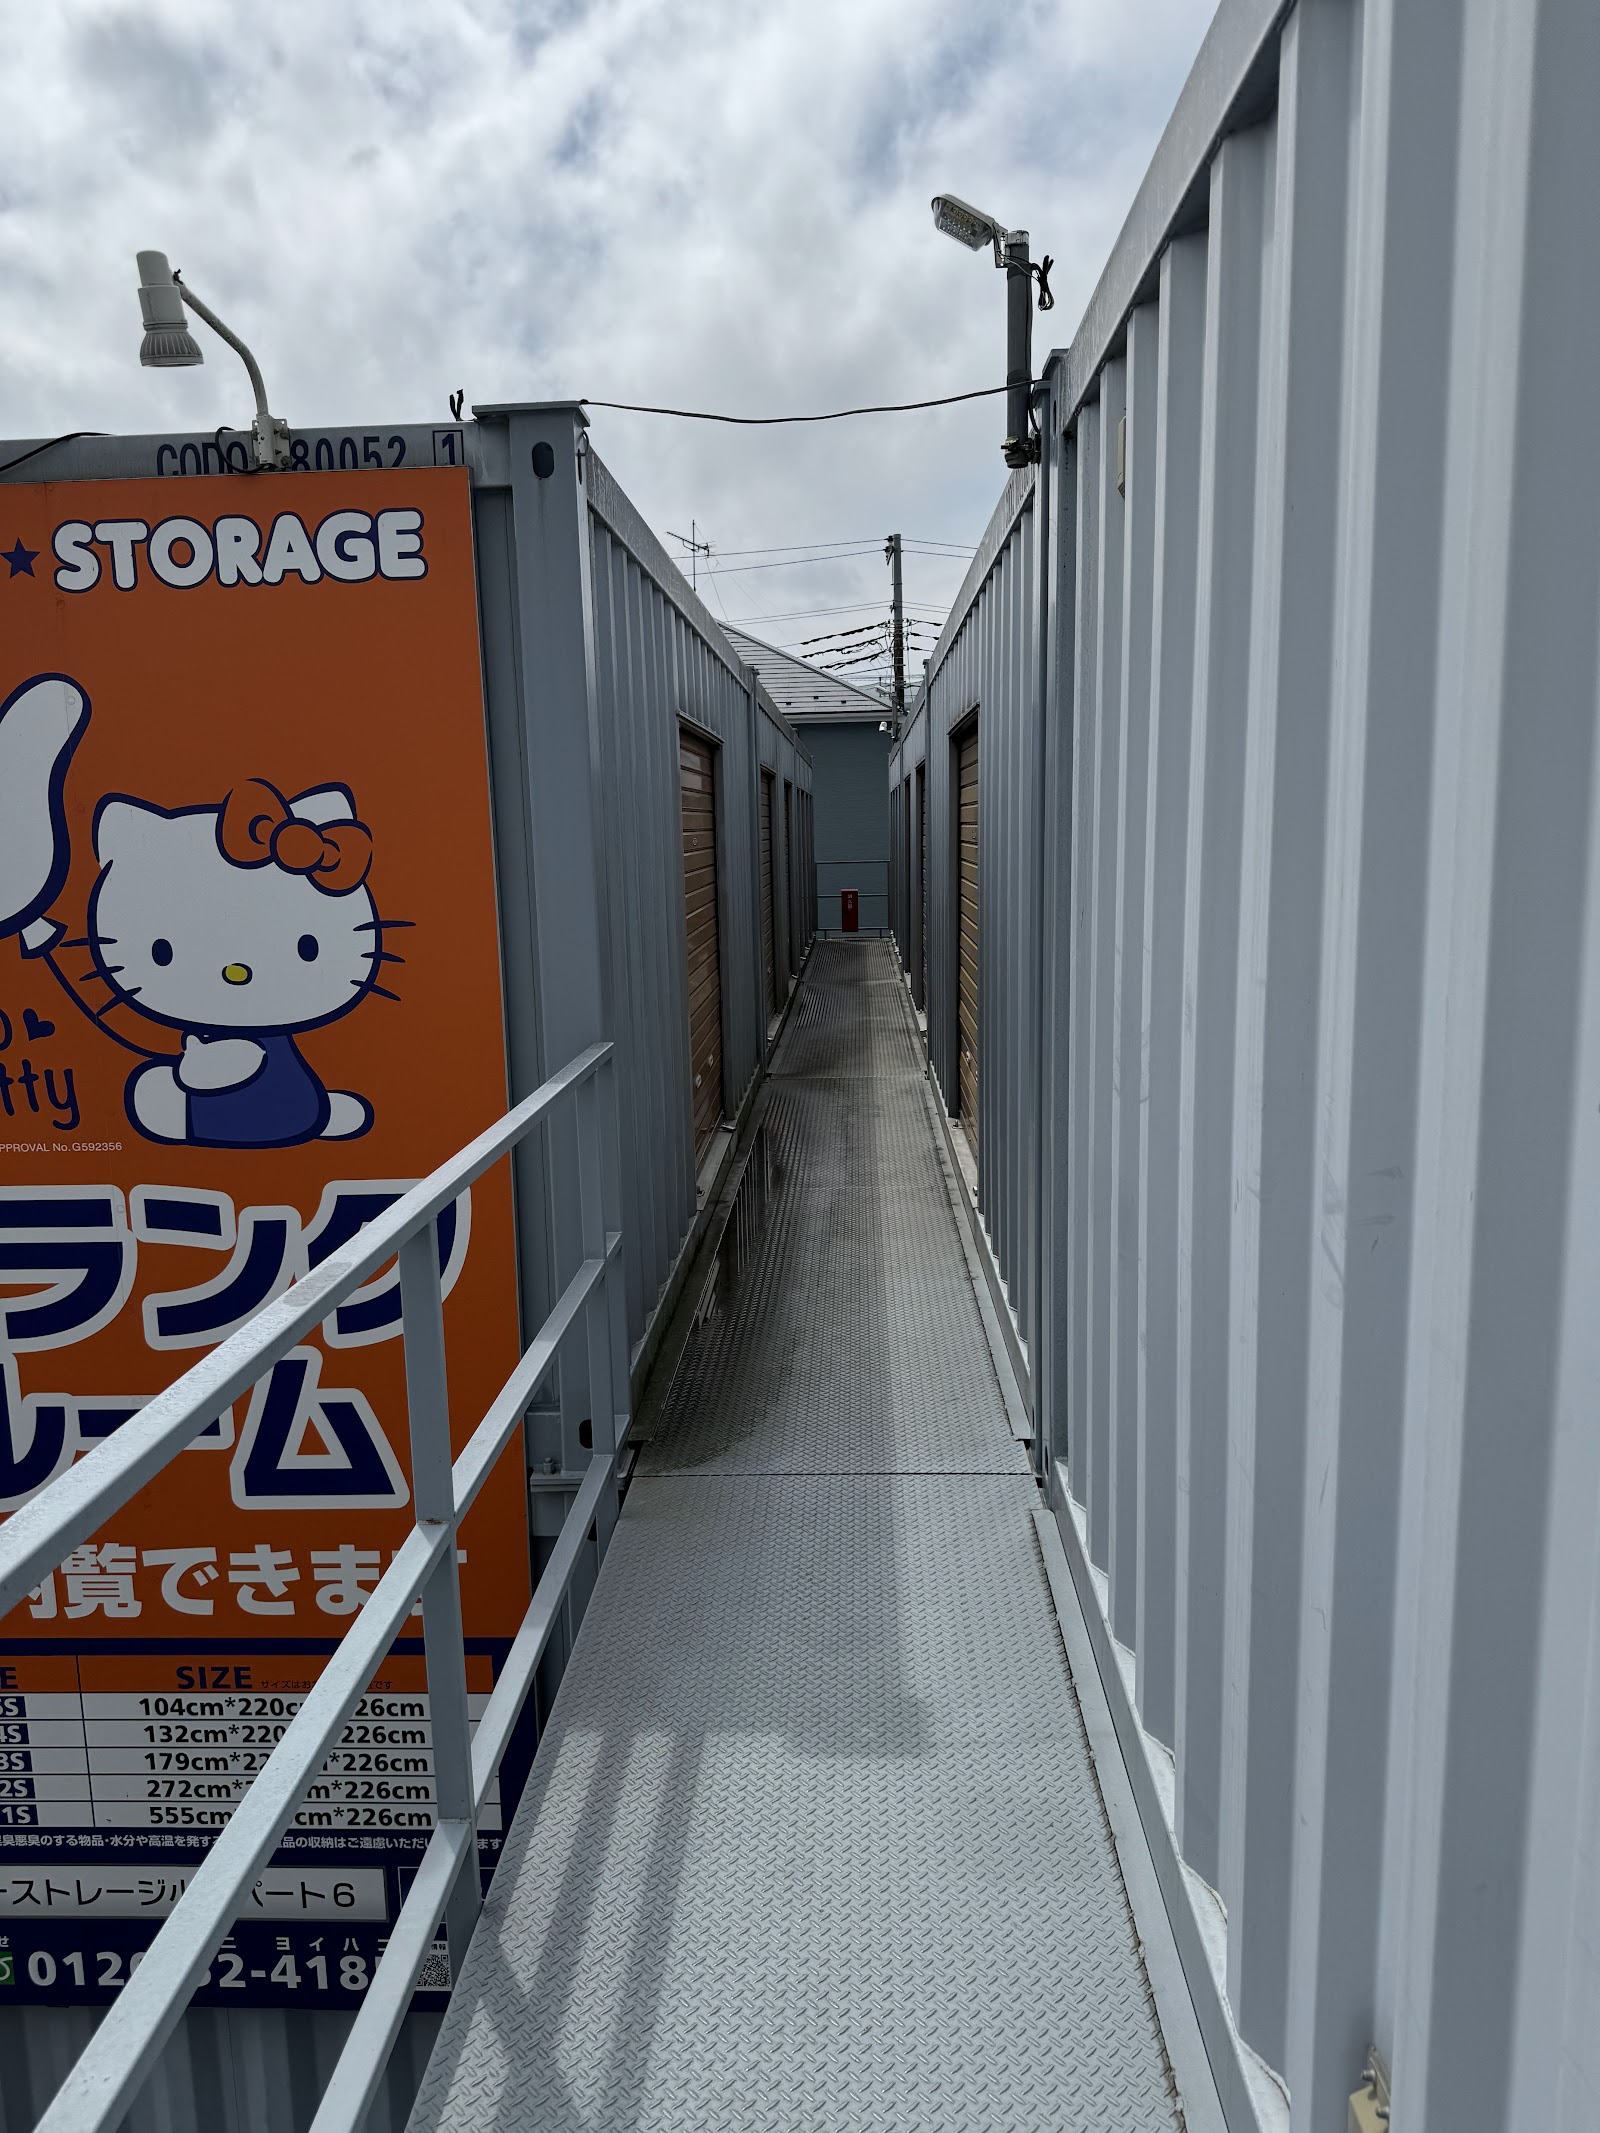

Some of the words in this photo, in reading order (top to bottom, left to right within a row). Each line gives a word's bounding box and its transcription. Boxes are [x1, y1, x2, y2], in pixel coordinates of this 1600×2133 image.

[53, 508, 428, 593] STORAGE
[176, 1666, 253, 1689] SIZE
[0, 1779, 28, 1798] 2S
[2, 1806, 31, 1825] 1S
